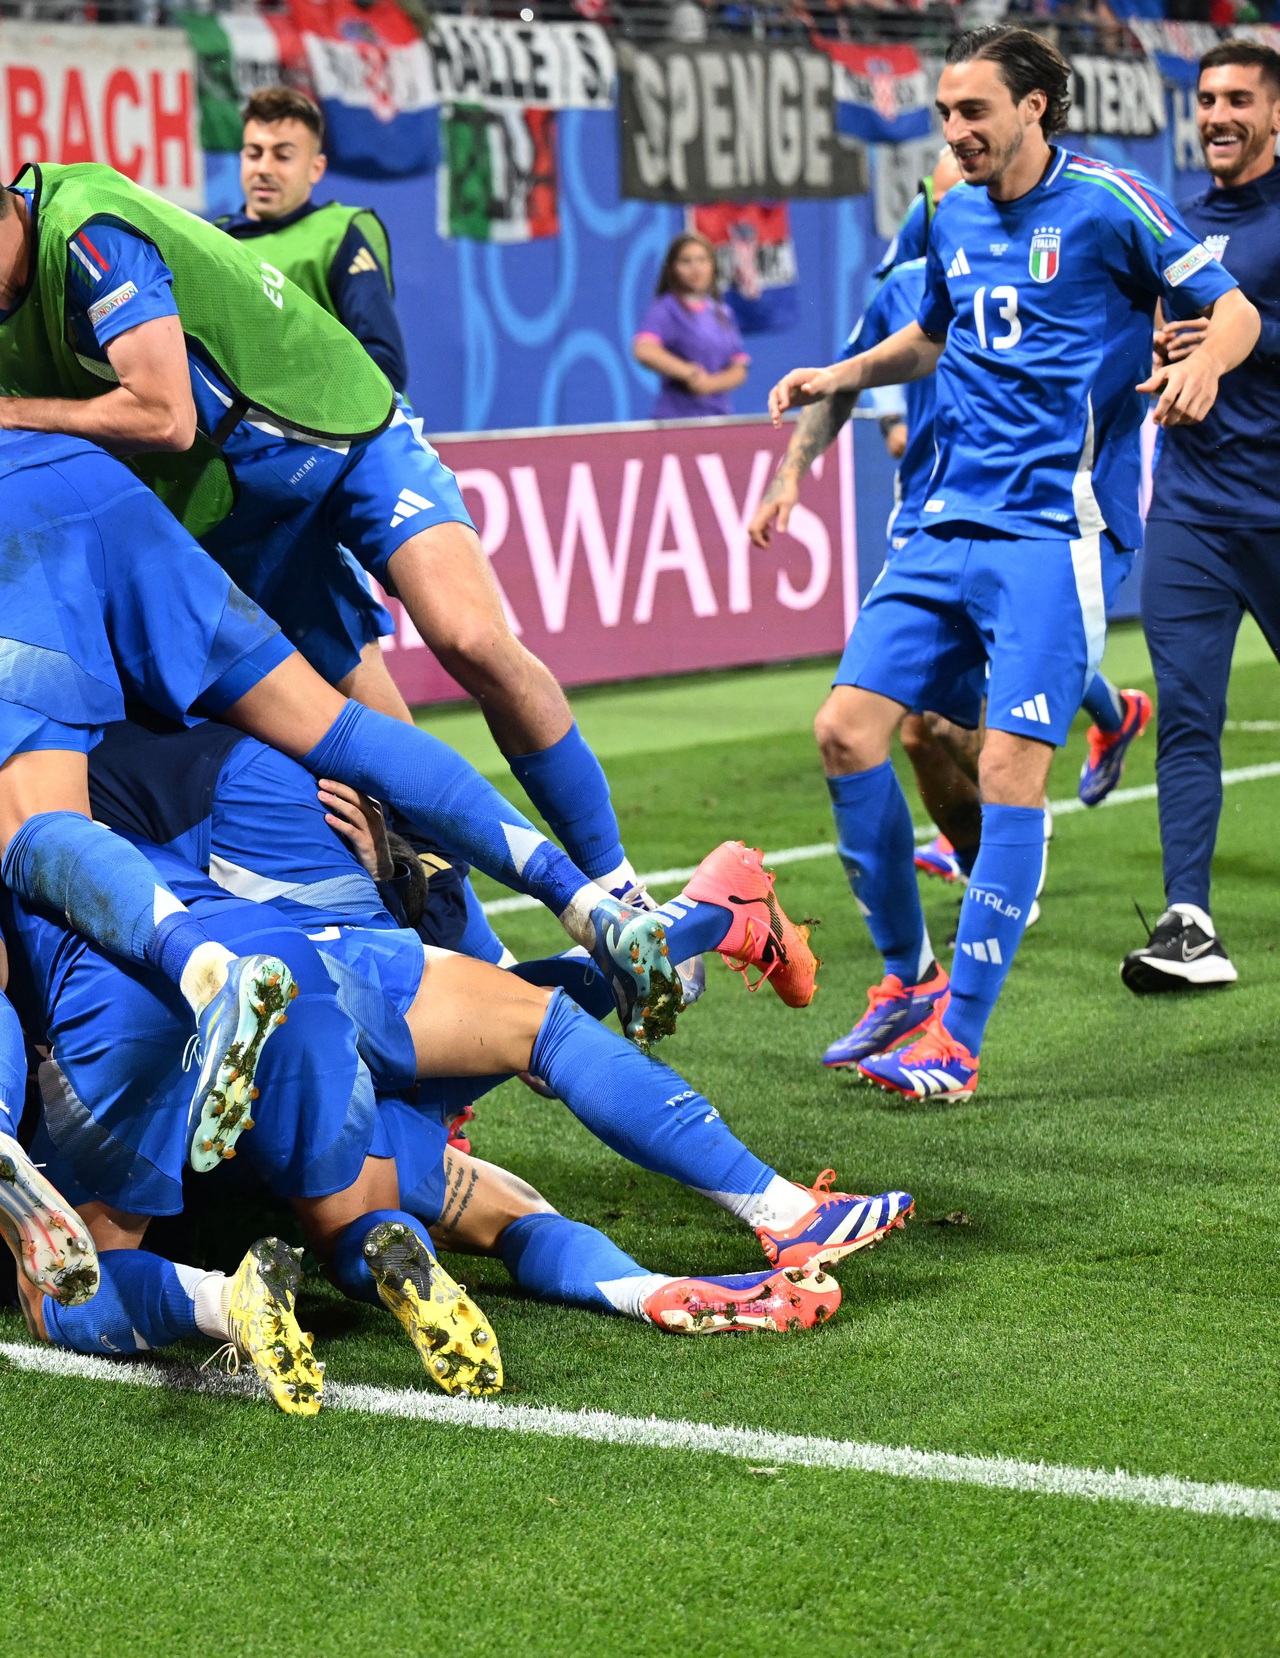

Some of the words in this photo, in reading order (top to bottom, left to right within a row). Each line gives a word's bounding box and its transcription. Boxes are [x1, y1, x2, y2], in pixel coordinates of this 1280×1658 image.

[633, 48, 834, 191] SPENGE
[1033, 238, 1058, 249] ITALIA
[973, 285, 1022, 350] 13
[289, 455, 317, 485] HEAT.RDY
[366, 449, 832, 652] RWAYS
[969, 887, 1022, 921] ITALIA
